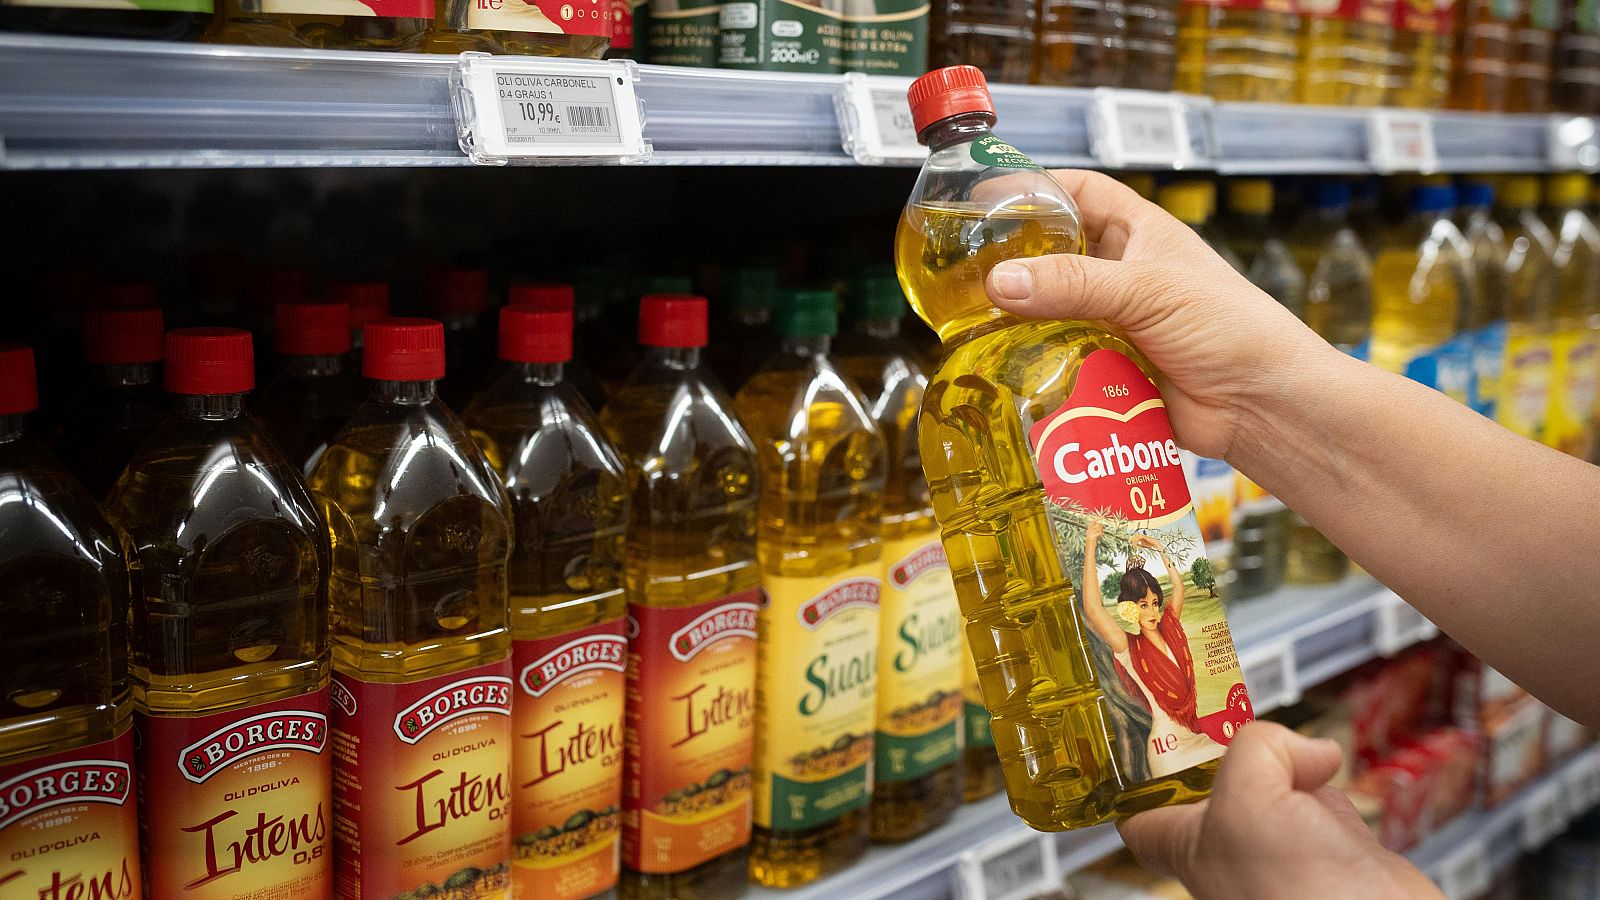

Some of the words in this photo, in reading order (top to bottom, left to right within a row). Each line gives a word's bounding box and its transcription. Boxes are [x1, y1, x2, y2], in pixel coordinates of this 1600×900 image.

[497, 77, 513, 86] OLI
[514, 78, 543, 87] OLIVA
[543, 78, 597, 89] CARBONELL
[499, 90, 513, 99] 0.4
[514, 90, 547, 99] GRAUS
[548, 91, 553, 99] 1
[1102, 384, 1129, 398] 1866
[1053, 433, 1181, 484] Carbone
[1125, 473, 1158, 485] ORIGINAL
[1129, 483, 1166, 517] 0,4
[688, 609, 757, 647] BORGES
[1201, 623, 1217, 634] ACEITE
[1217, 621, 1225, 630] DE
[541, 642, 623, 682] BORGES
[1207, 647, 1225, 659] ACEITES
[1209, 668, 1217, 676] DE
[1216, 664, 1231, 674] OLIVA
[416, 685, 509, 727] BORGES
[670, 683, 752, 749] Inten
[204, 719, 318, 766] BORGES
[432, 751, 450, 761] OLI
[452, 738, 497, 756] D'OLIVA
[233, 755, 266, 770] MESTRES
[266, 753, 279, 761] DES
[280, 751, 291, 759] DE
[246, 759, 278, 773] 1896
[223, 790, 245, 802] OLI
[247, 776, 301, 797] D'OLIVA
[10, 848, 36, 862] OLI
[38, 831, 102, 855] D'OLIVA
[179, 800, 327, 892] Intens
